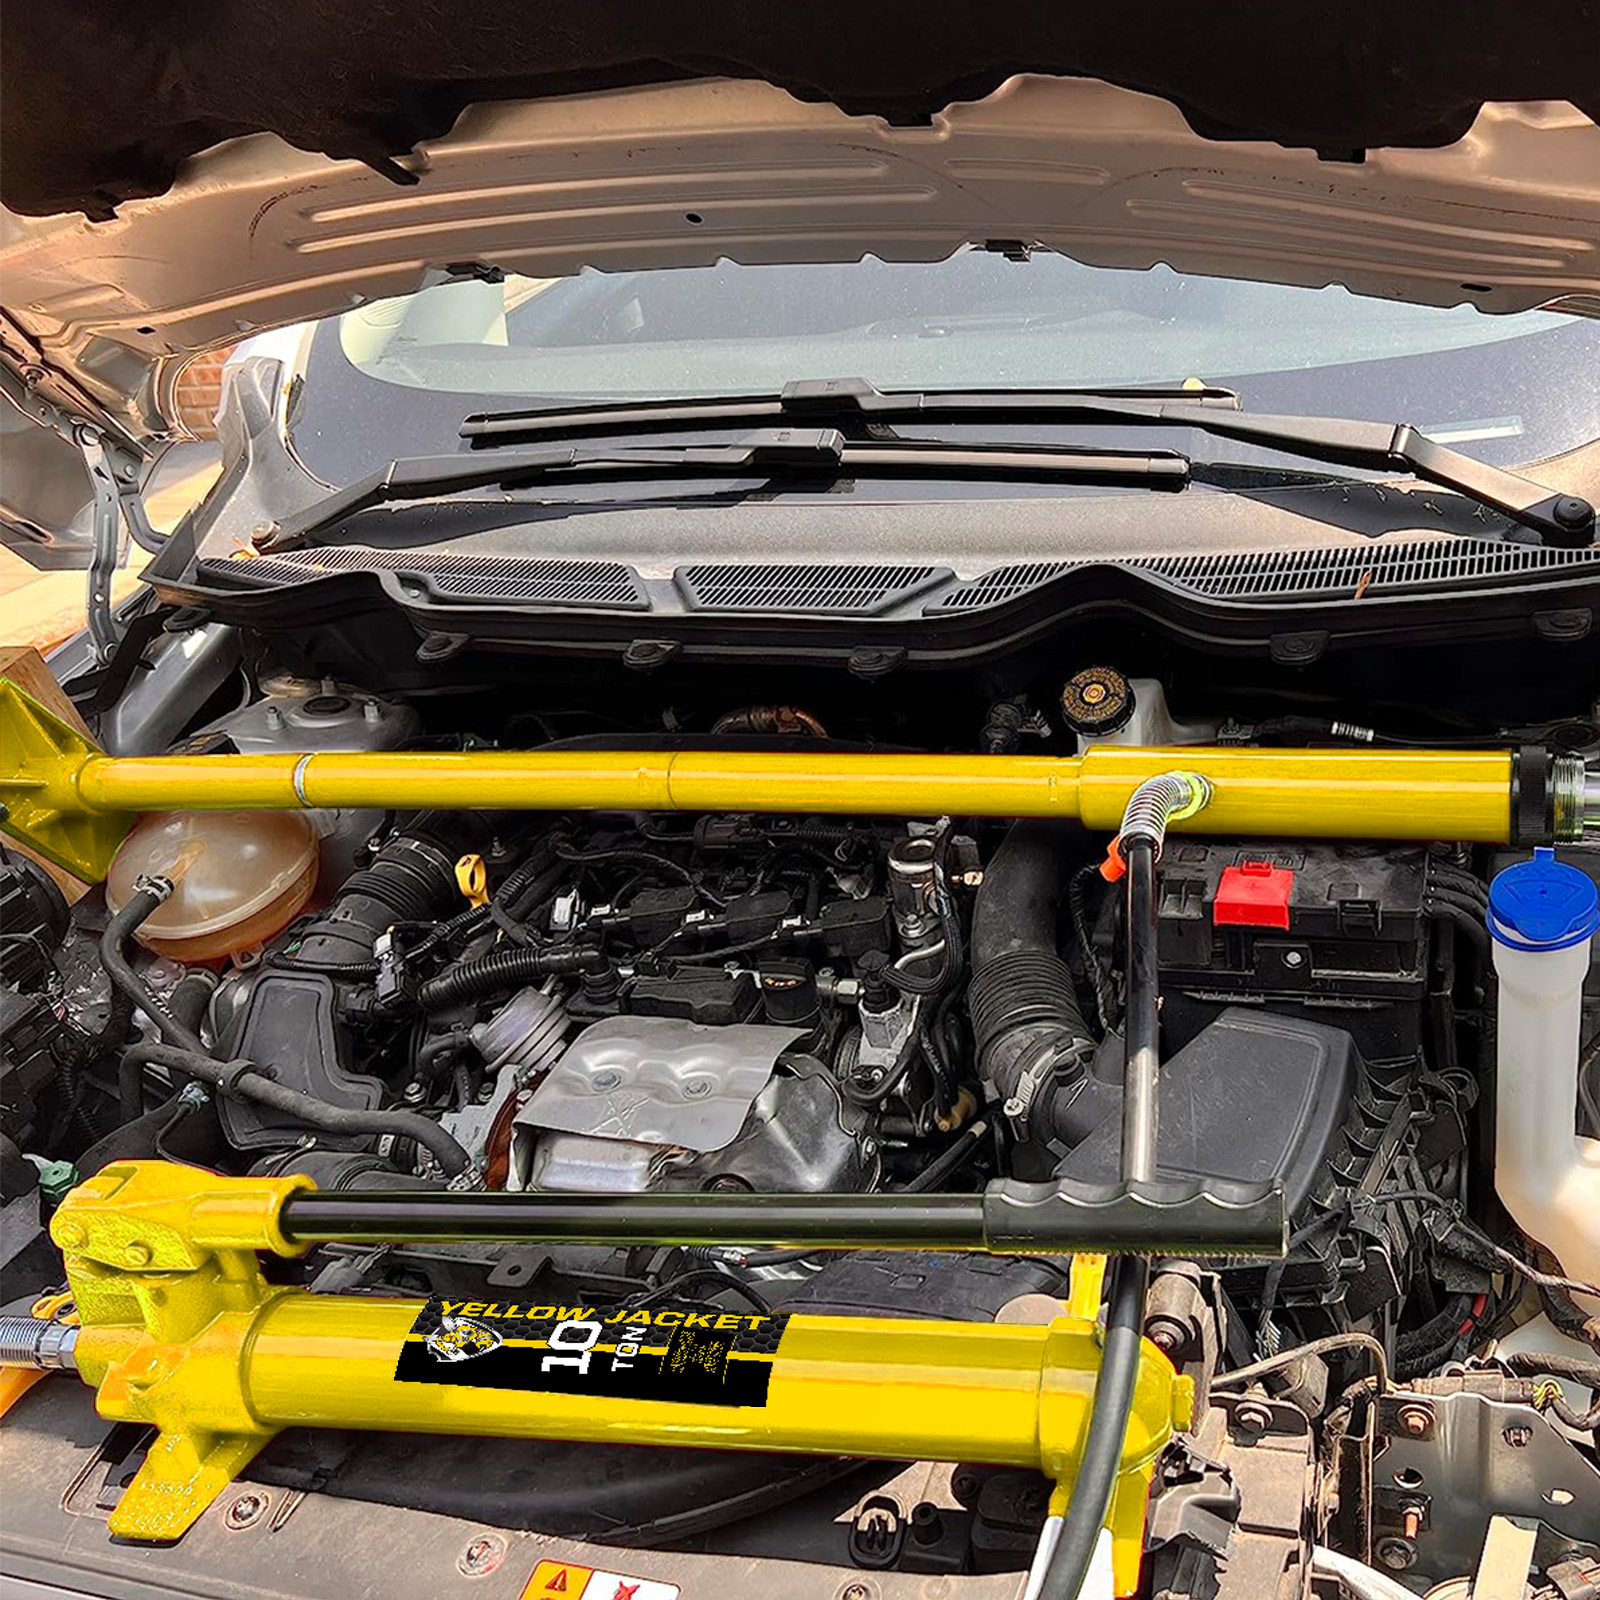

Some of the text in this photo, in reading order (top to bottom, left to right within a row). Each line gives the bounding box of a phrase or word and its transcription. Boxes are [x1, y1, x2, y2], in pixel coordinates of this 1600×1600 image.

[441, 1301, 771, 1330] YELLOW JACKET
[541, 1320, 602, 1374] 10
[611, 1326, 647, 1372] TON
